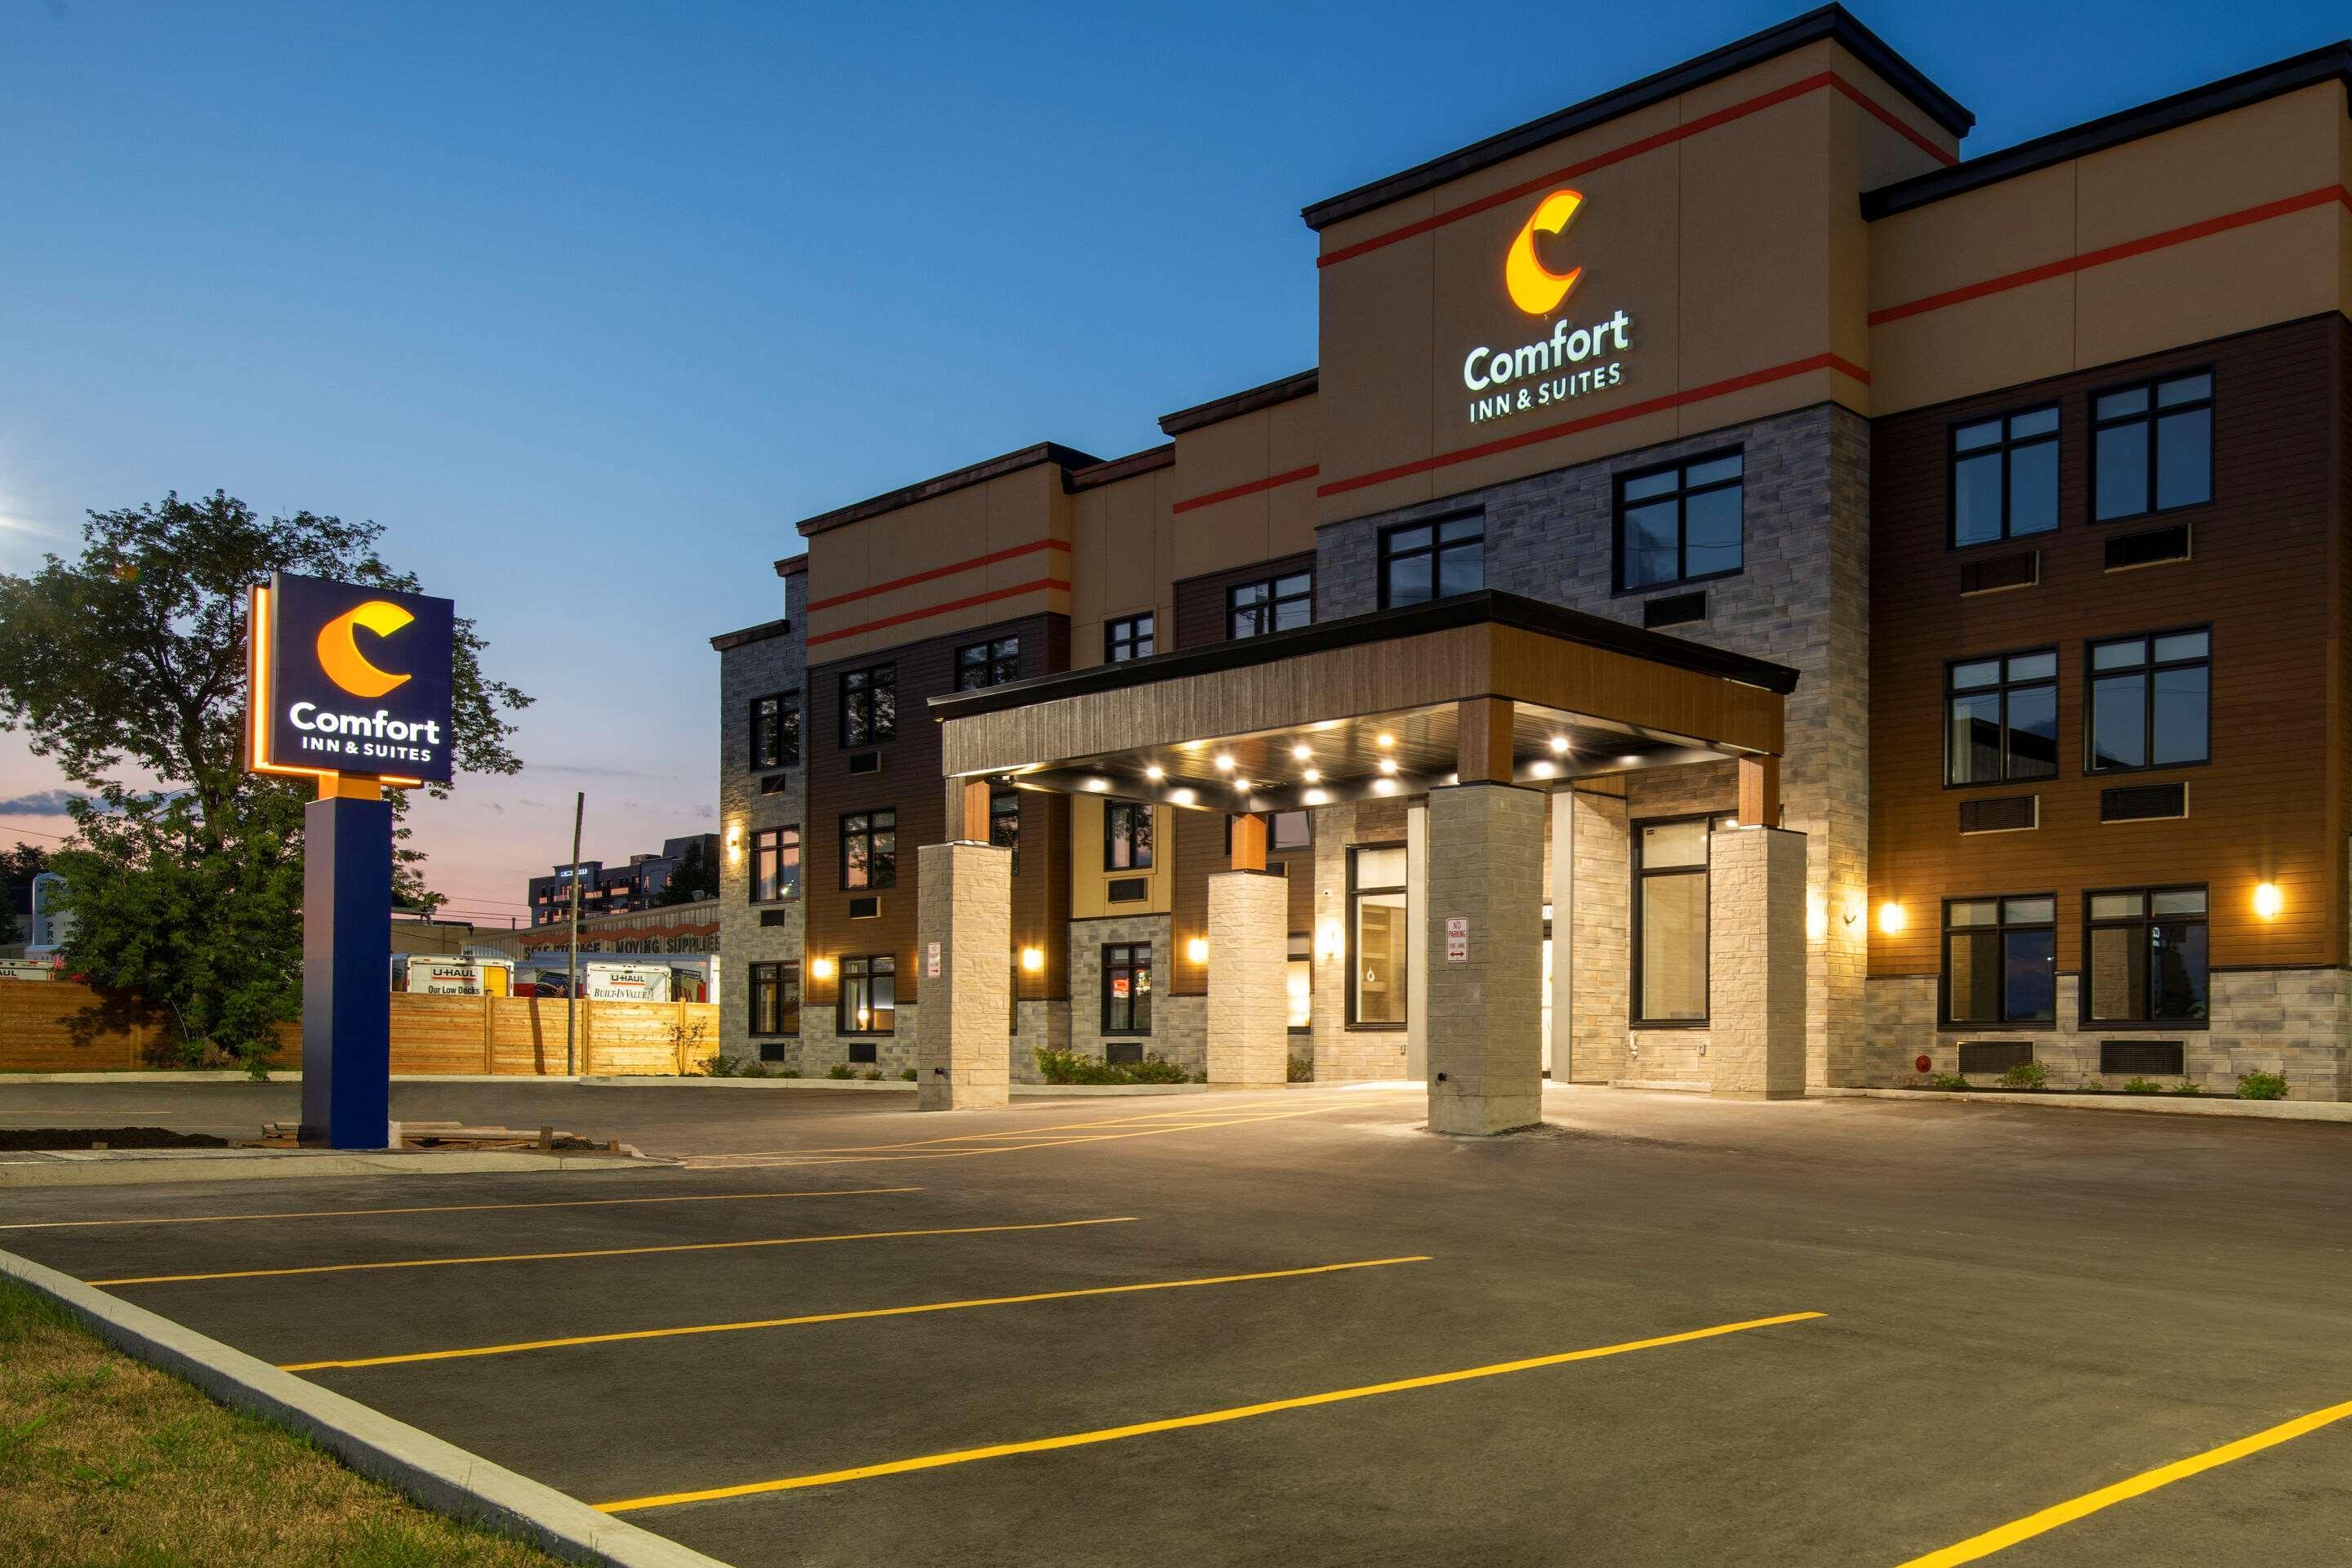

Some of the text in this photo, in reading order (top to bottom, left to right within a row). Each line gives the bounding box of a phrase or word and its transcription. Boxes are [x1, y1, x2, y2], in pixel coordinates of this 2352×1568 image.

[1464, 310, 1628, 391] Comfort
[1470, 363, 1620, 423] INN & SUITES
[290, 702, 440, 745] Comfort
[302, 736, 431, 762] INN & SUITES
[1453, 921, 1462, 929] NO
[615, 938, 660, 954] MOVING
[433, 969, 476, 977] U-HAUL
[611, 974, 645, 982] U-HAUL
[428, 985, 480, 995] Our Low Decks
